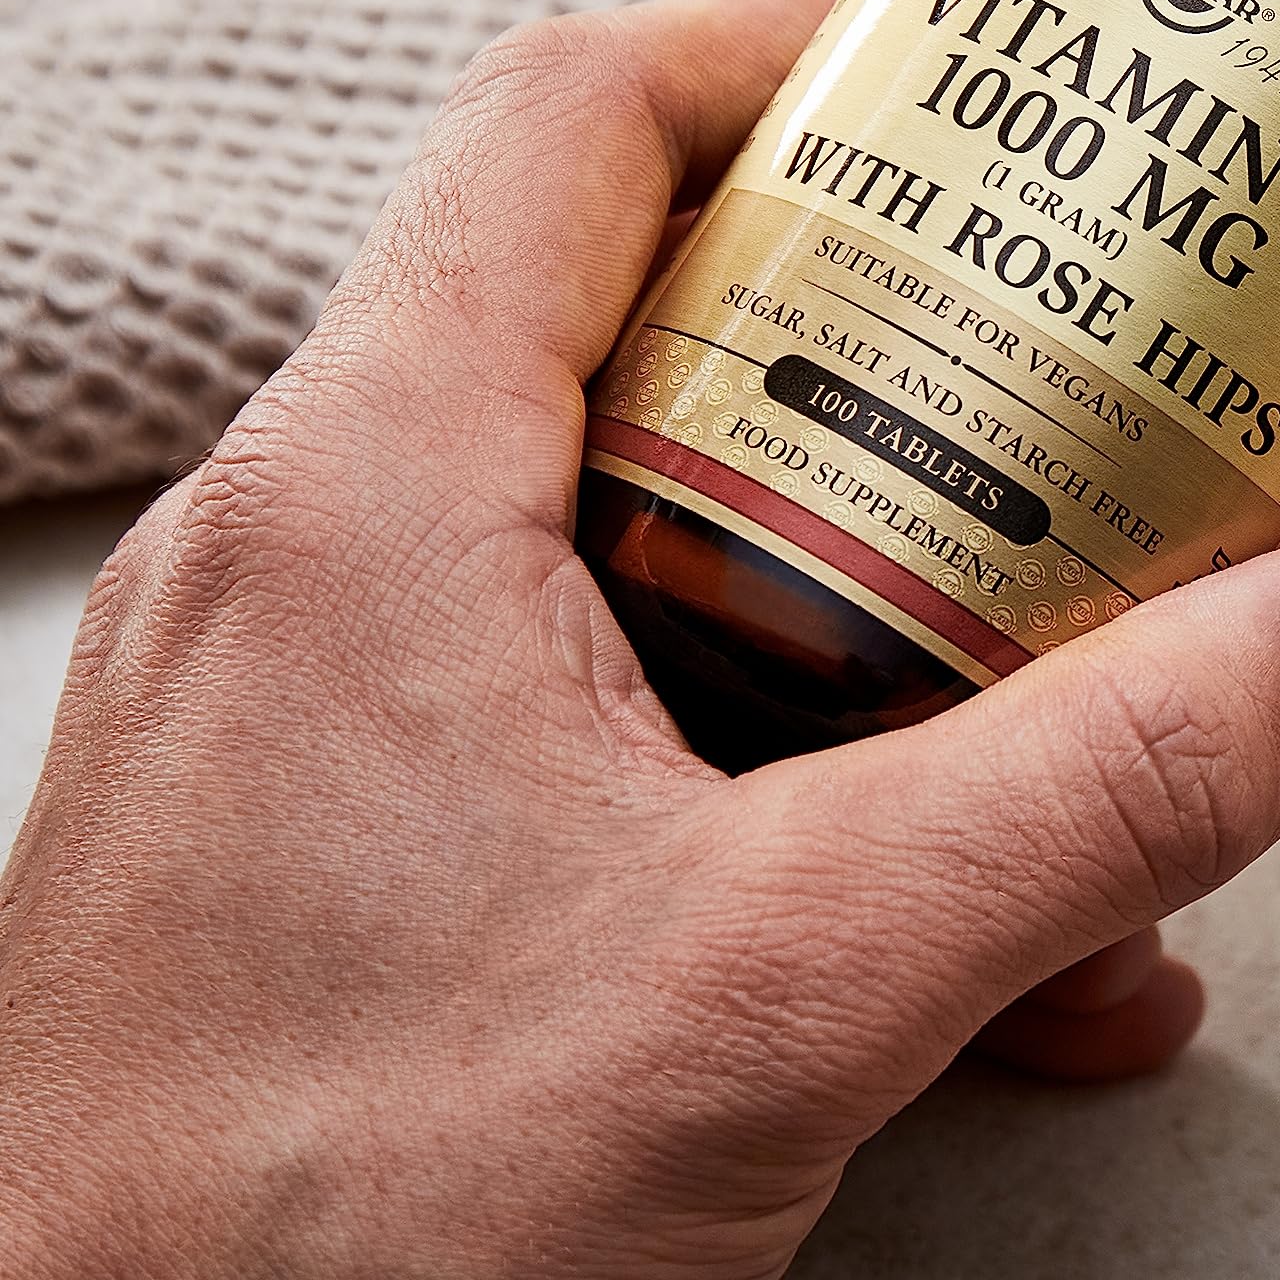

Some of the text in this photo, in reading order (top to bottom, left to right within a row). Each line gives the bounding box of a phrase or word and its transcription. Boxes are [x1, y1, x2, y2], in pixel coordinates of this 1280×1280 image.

[783, 132, 946, 234] WITH
[944, 203, 1135, 346] ROSE
[916, 53, 1269, 290] 1000 MG
[983, 160, 1128, 260] (1 GRAM)
[722, 283, 1165, 556] SUGAR, SALT AND STARCH FREE
[814, 236, 1148, 443] SUITABLE FOR VEGANS
[729, 418, 1014, 594] FOOD SUPPLEMENT
[808, 384, 1004, 510] 100 TABLETS
